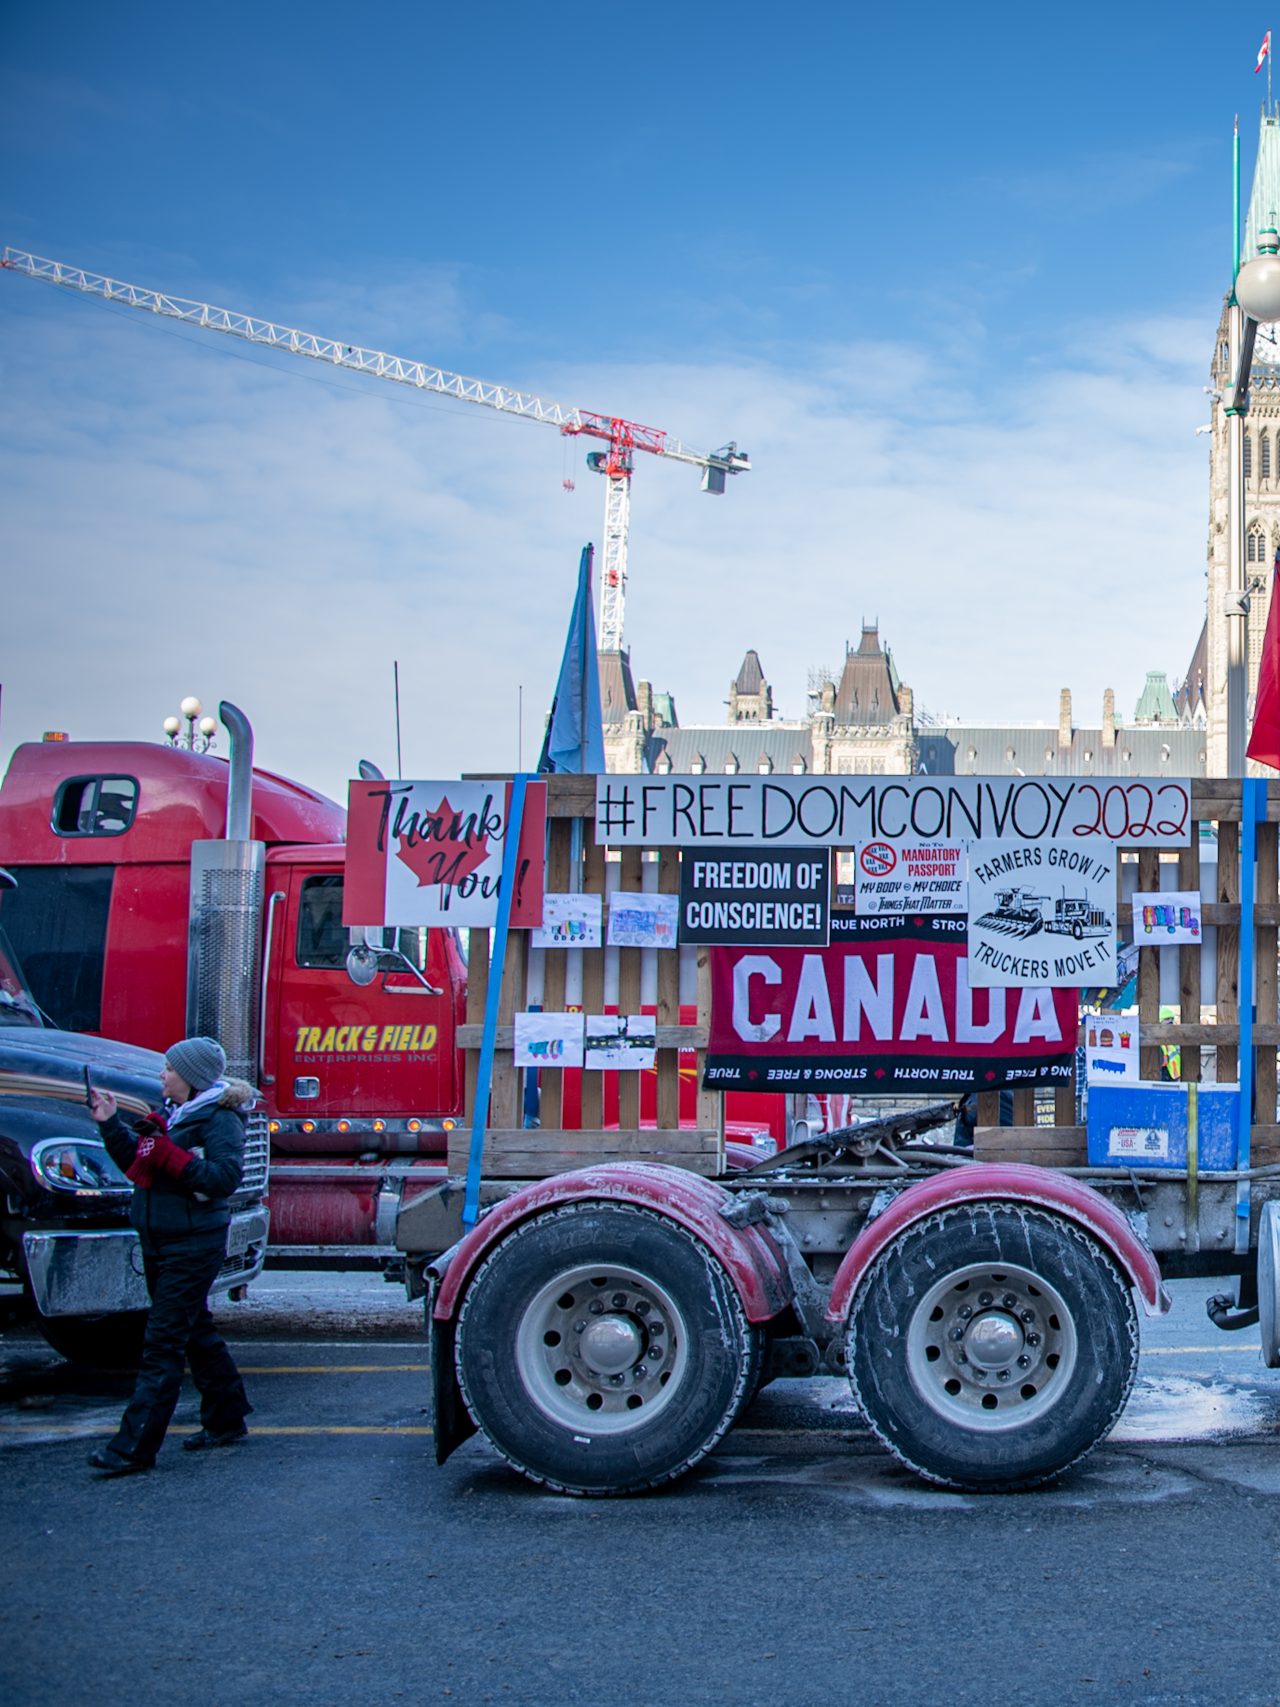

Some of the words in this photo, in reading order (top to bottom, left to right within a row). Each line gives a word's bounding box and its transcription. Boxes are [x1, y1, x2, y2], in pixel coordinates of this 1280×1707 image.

[367, 785, 508, 851] Thank
[598, 782, 1188, 839] #FREEDOMCONVOY2022
[902, 848, 961, 861] MANDATORY
[908, 864, 956, 877] PASSPORT
[975, 847, 1042, 885] FARMERS
[1048, 847, 1094, 875] GROW
[1091, 864, 1110, 884] IT
[693, 862, 791, 889] FREEDOM
[796, 863, 823, 890] OF
[860, 881, 876, 895] MY
[875, 881, 902, 894] BODY
[912, 881, 929, 893] MY
[928, 880, 962, 893] CHOICE
[686, 901, 822, 930] CONSCIENCE!
[831, 919, 857, 930] RUE
[860, 916, 905, 930] NORTH
[932, 919, 968, 931] STRO
[974, 941, 1049, 979] TRUCKERS
[1054, 950, 1096, 978] MOVE
[1094, 941, 1111, 962] IT
[732, 953, 1063, 1044] CANADA
[294, 1025, 363, 1052] TRACK
[378, 1024, 438, 1051] FIELD
[294, 1054, 402, 1063] ENTERPRISES
[406, 1053, 438, 1062] INC
[708, 1067, 741, 1080] TRUE
[766, 1068, 800, 1080] FREE
[814, 1068, 868, 1080] STRONG
[894, 1067, 939, 1080] NORTH
[941, 1068, 975, 1081] TRUE
[1120, 1139, 1134, 1148] USA
